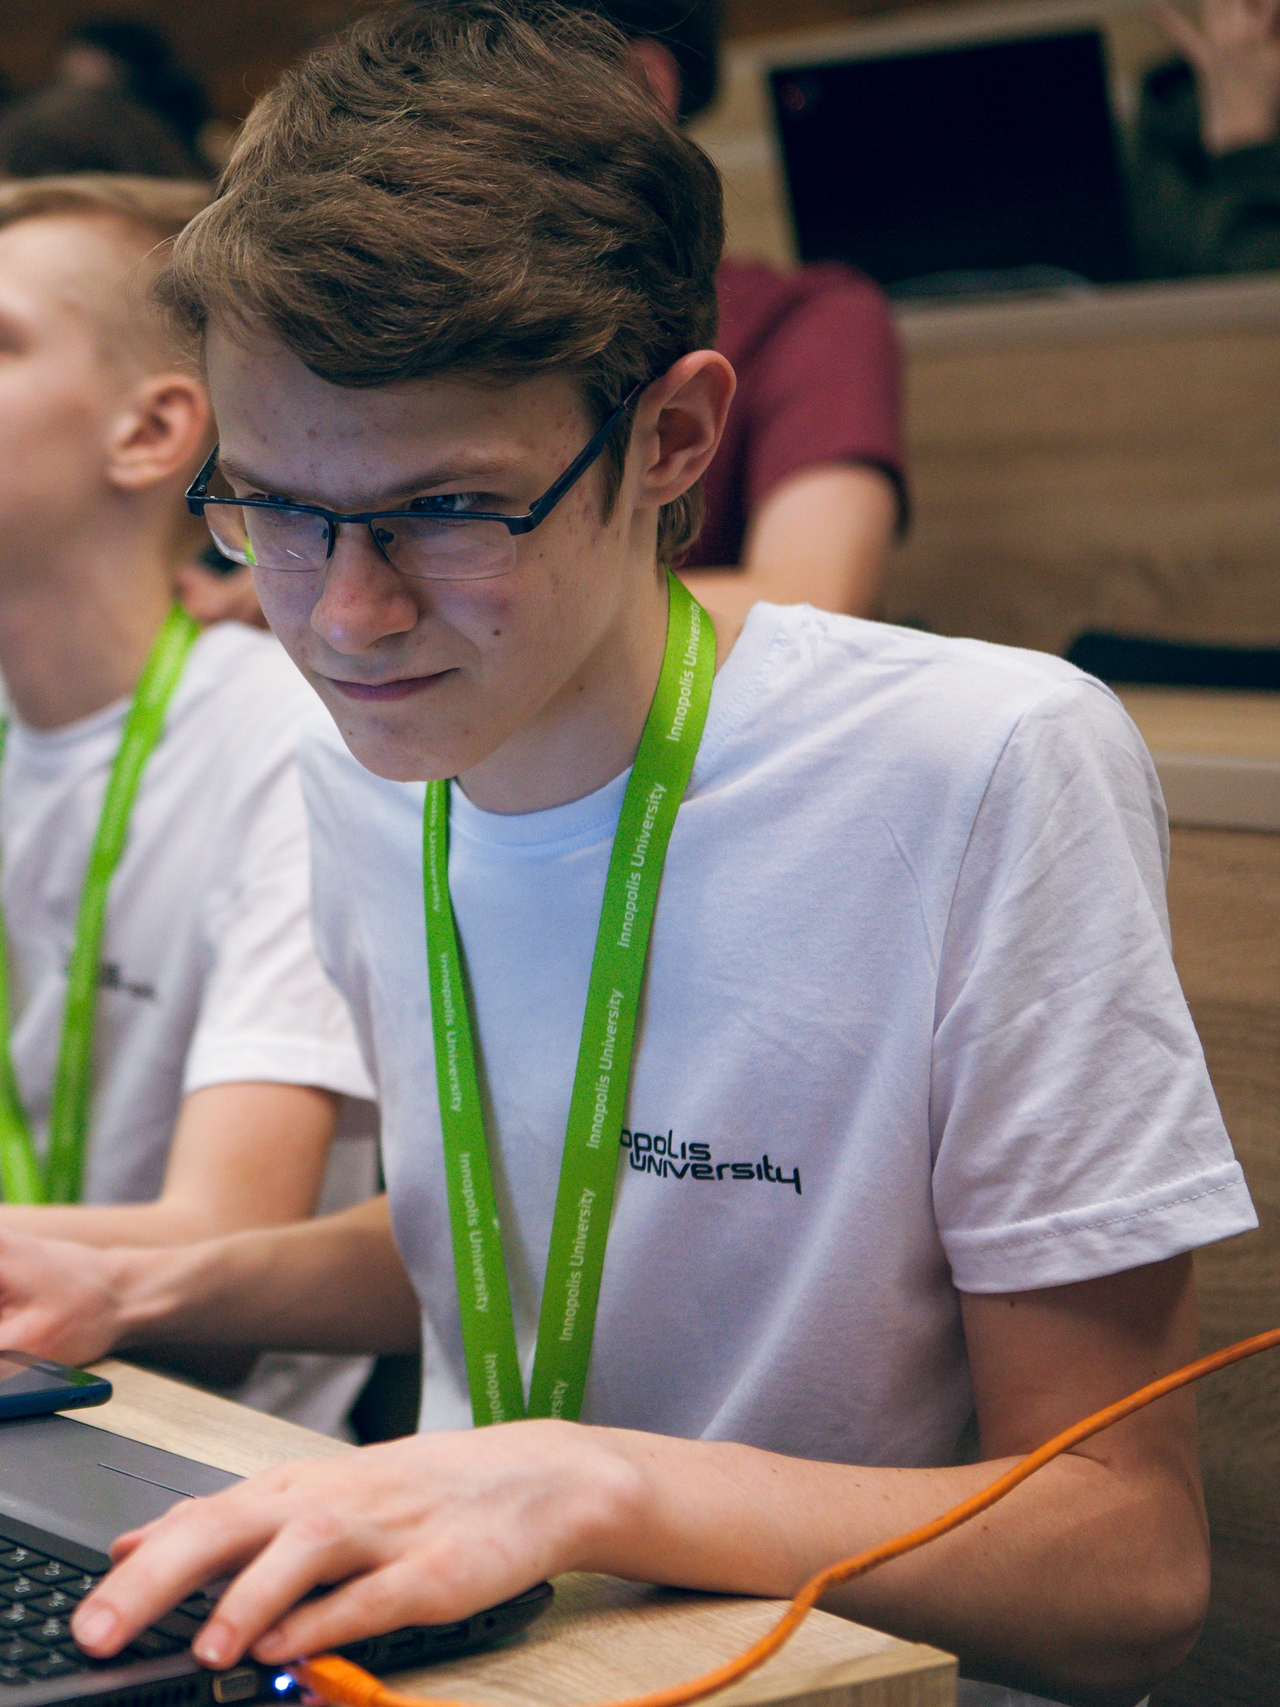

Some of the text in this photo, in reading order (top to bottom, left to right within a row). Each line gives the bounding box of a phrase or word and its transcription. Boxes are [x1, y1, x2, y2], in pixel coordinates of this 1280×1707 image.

[666, 600, 701, 742] Innopolis University
[617, 782, 667, 949] Innopolis University
[440, 952, 462, 1112] Innopolis University
[586, 989, 624, 1149] Innopolis University
[619, 1129, 712, 1163] opolis
[459, 1153, 489, 1313] Innopolis University
[559, 1188, 597, 1341] Innopolis University
